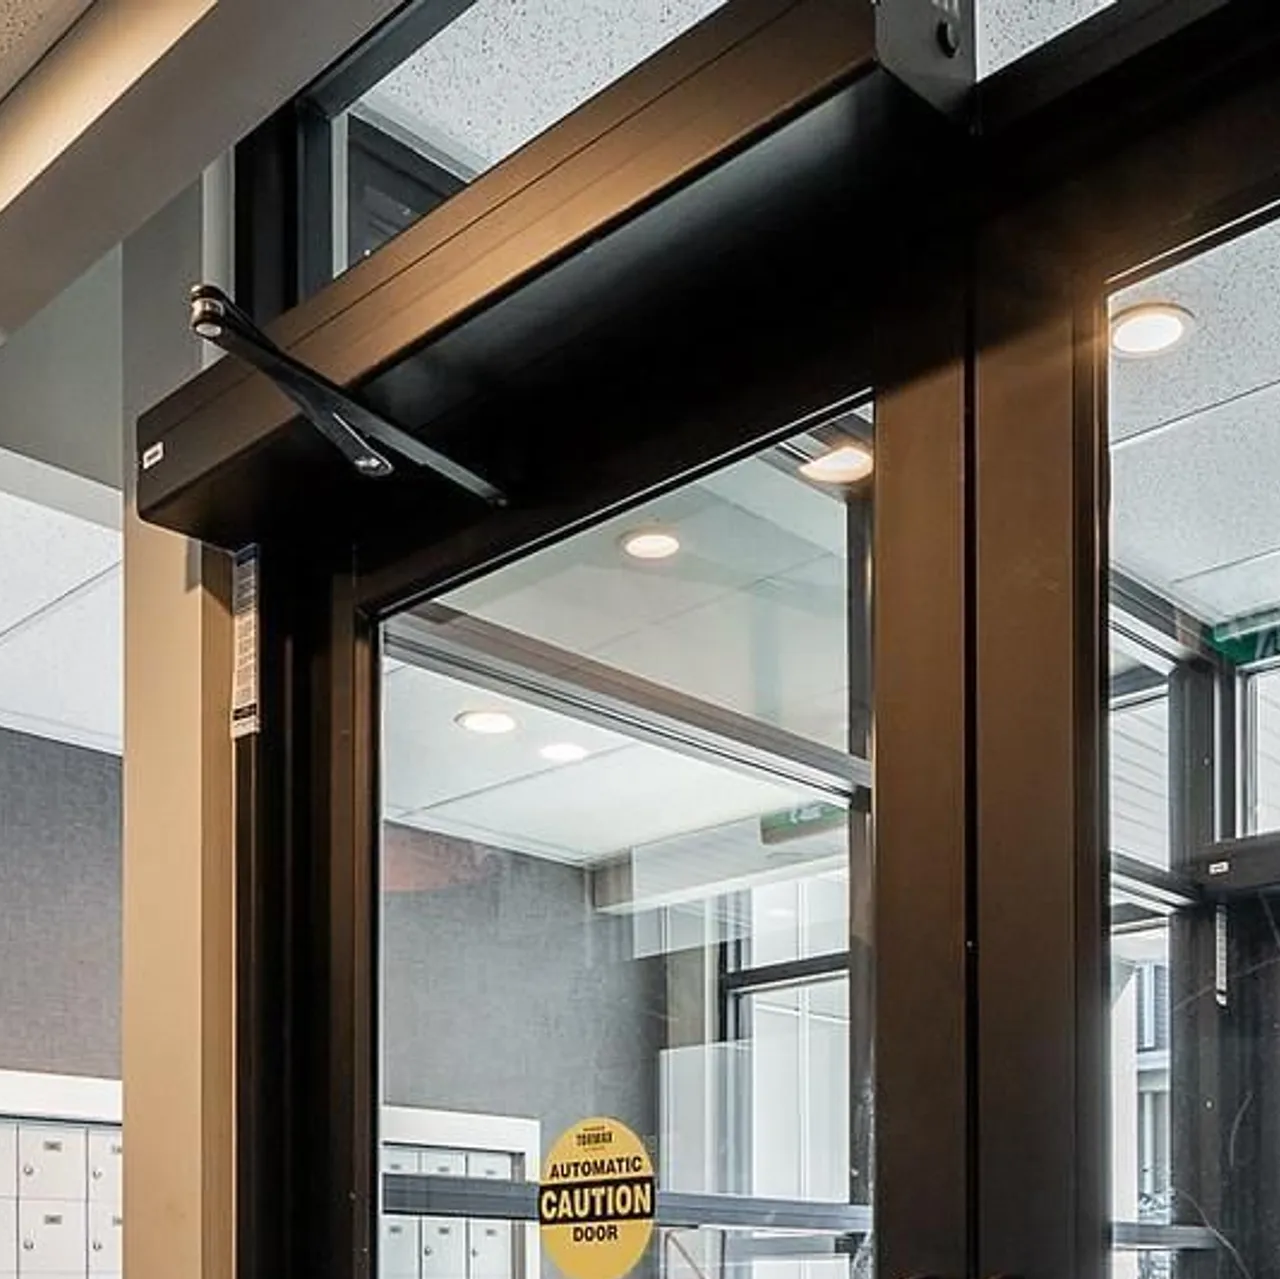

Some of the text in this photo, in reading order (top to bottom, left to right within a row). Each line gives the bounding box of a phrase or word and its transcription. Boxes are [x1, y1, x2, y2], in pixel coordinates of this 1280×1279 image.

[549, 1156, 643, 1180] AUTOMATIC
[541, 1183, 652, 1220] CAUTION
[572, 1225, 618, 1242] DOOR
